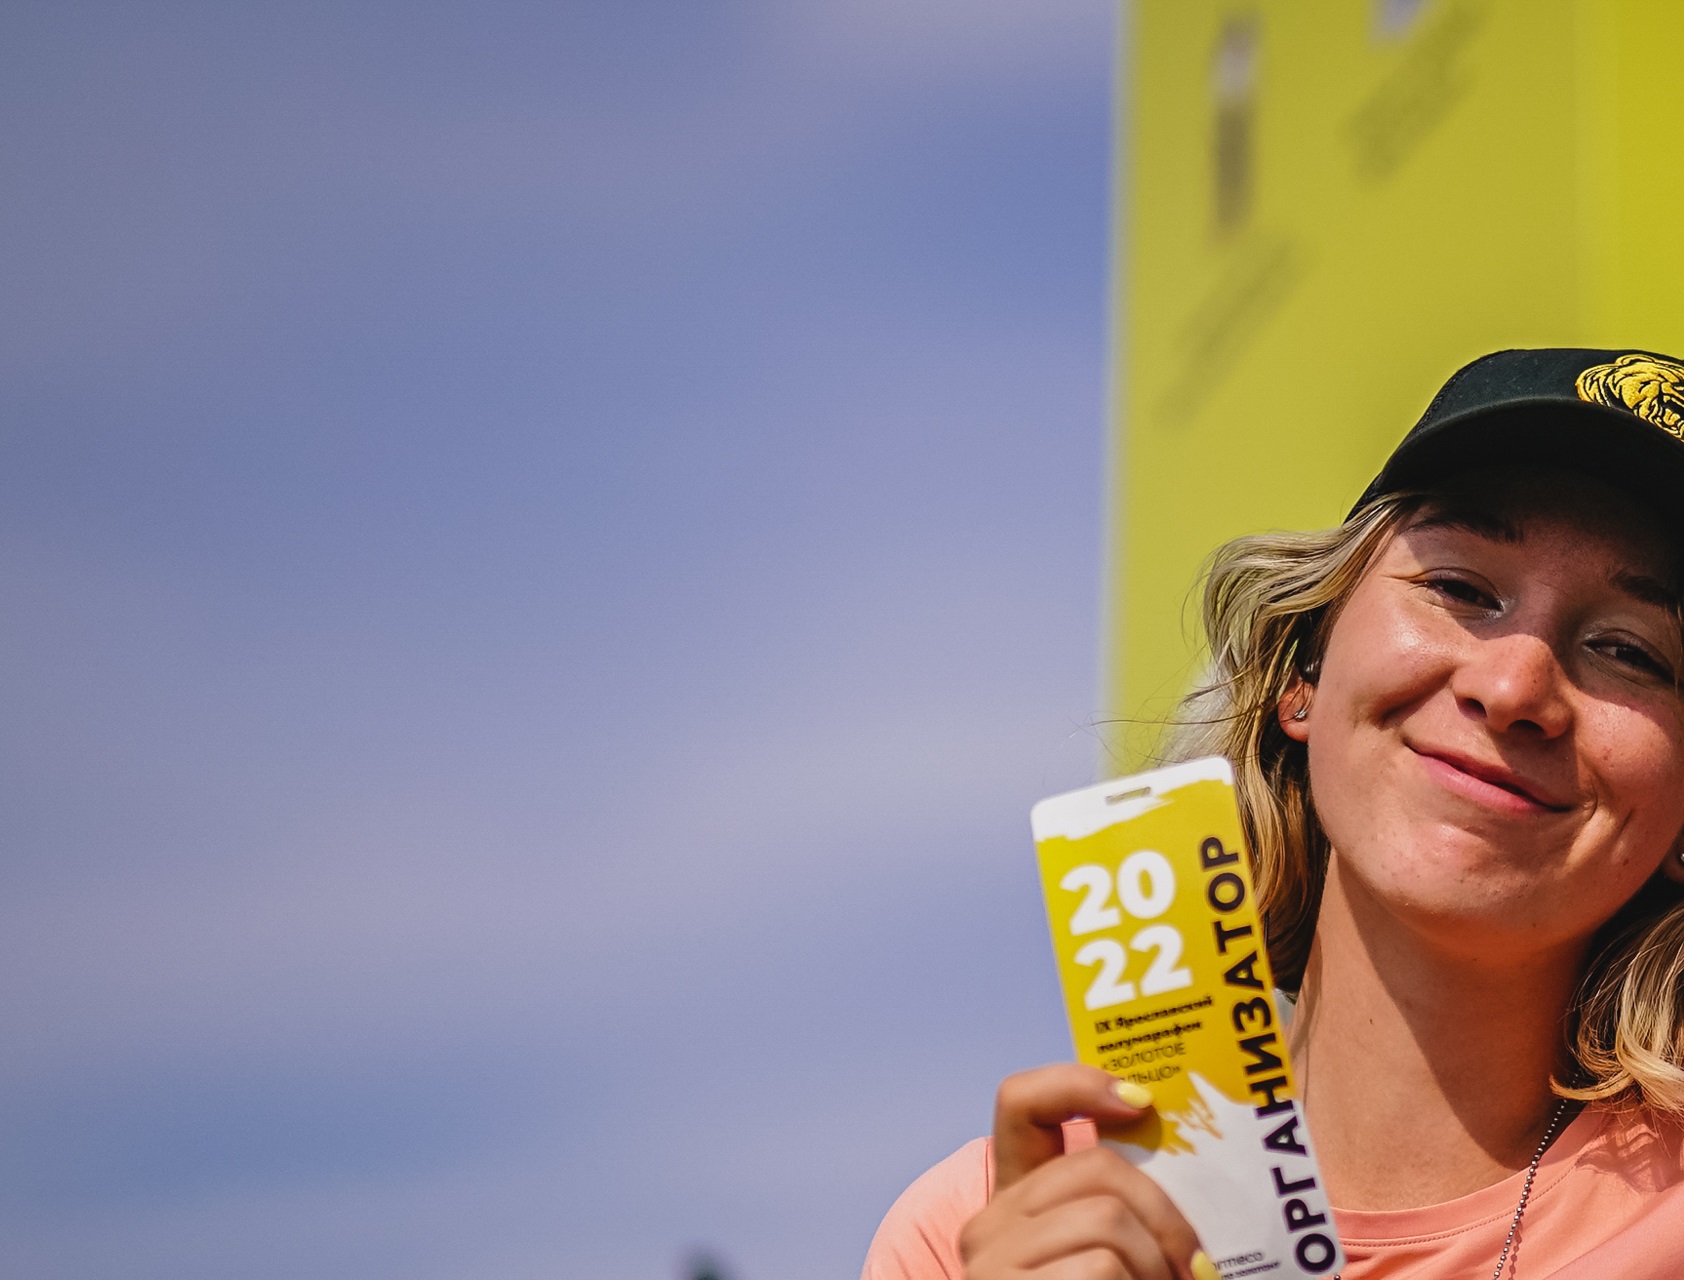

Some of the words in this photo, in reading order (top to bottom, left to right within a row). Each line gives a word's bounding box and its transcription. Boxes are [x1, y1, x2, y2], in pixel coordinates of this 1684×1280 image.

[1060, 850, 1175, 935] 20
[1074, 925, 1192, 1010] 22
[1200, 836, 1337, 1275] ОРГАНИЗАТОР
